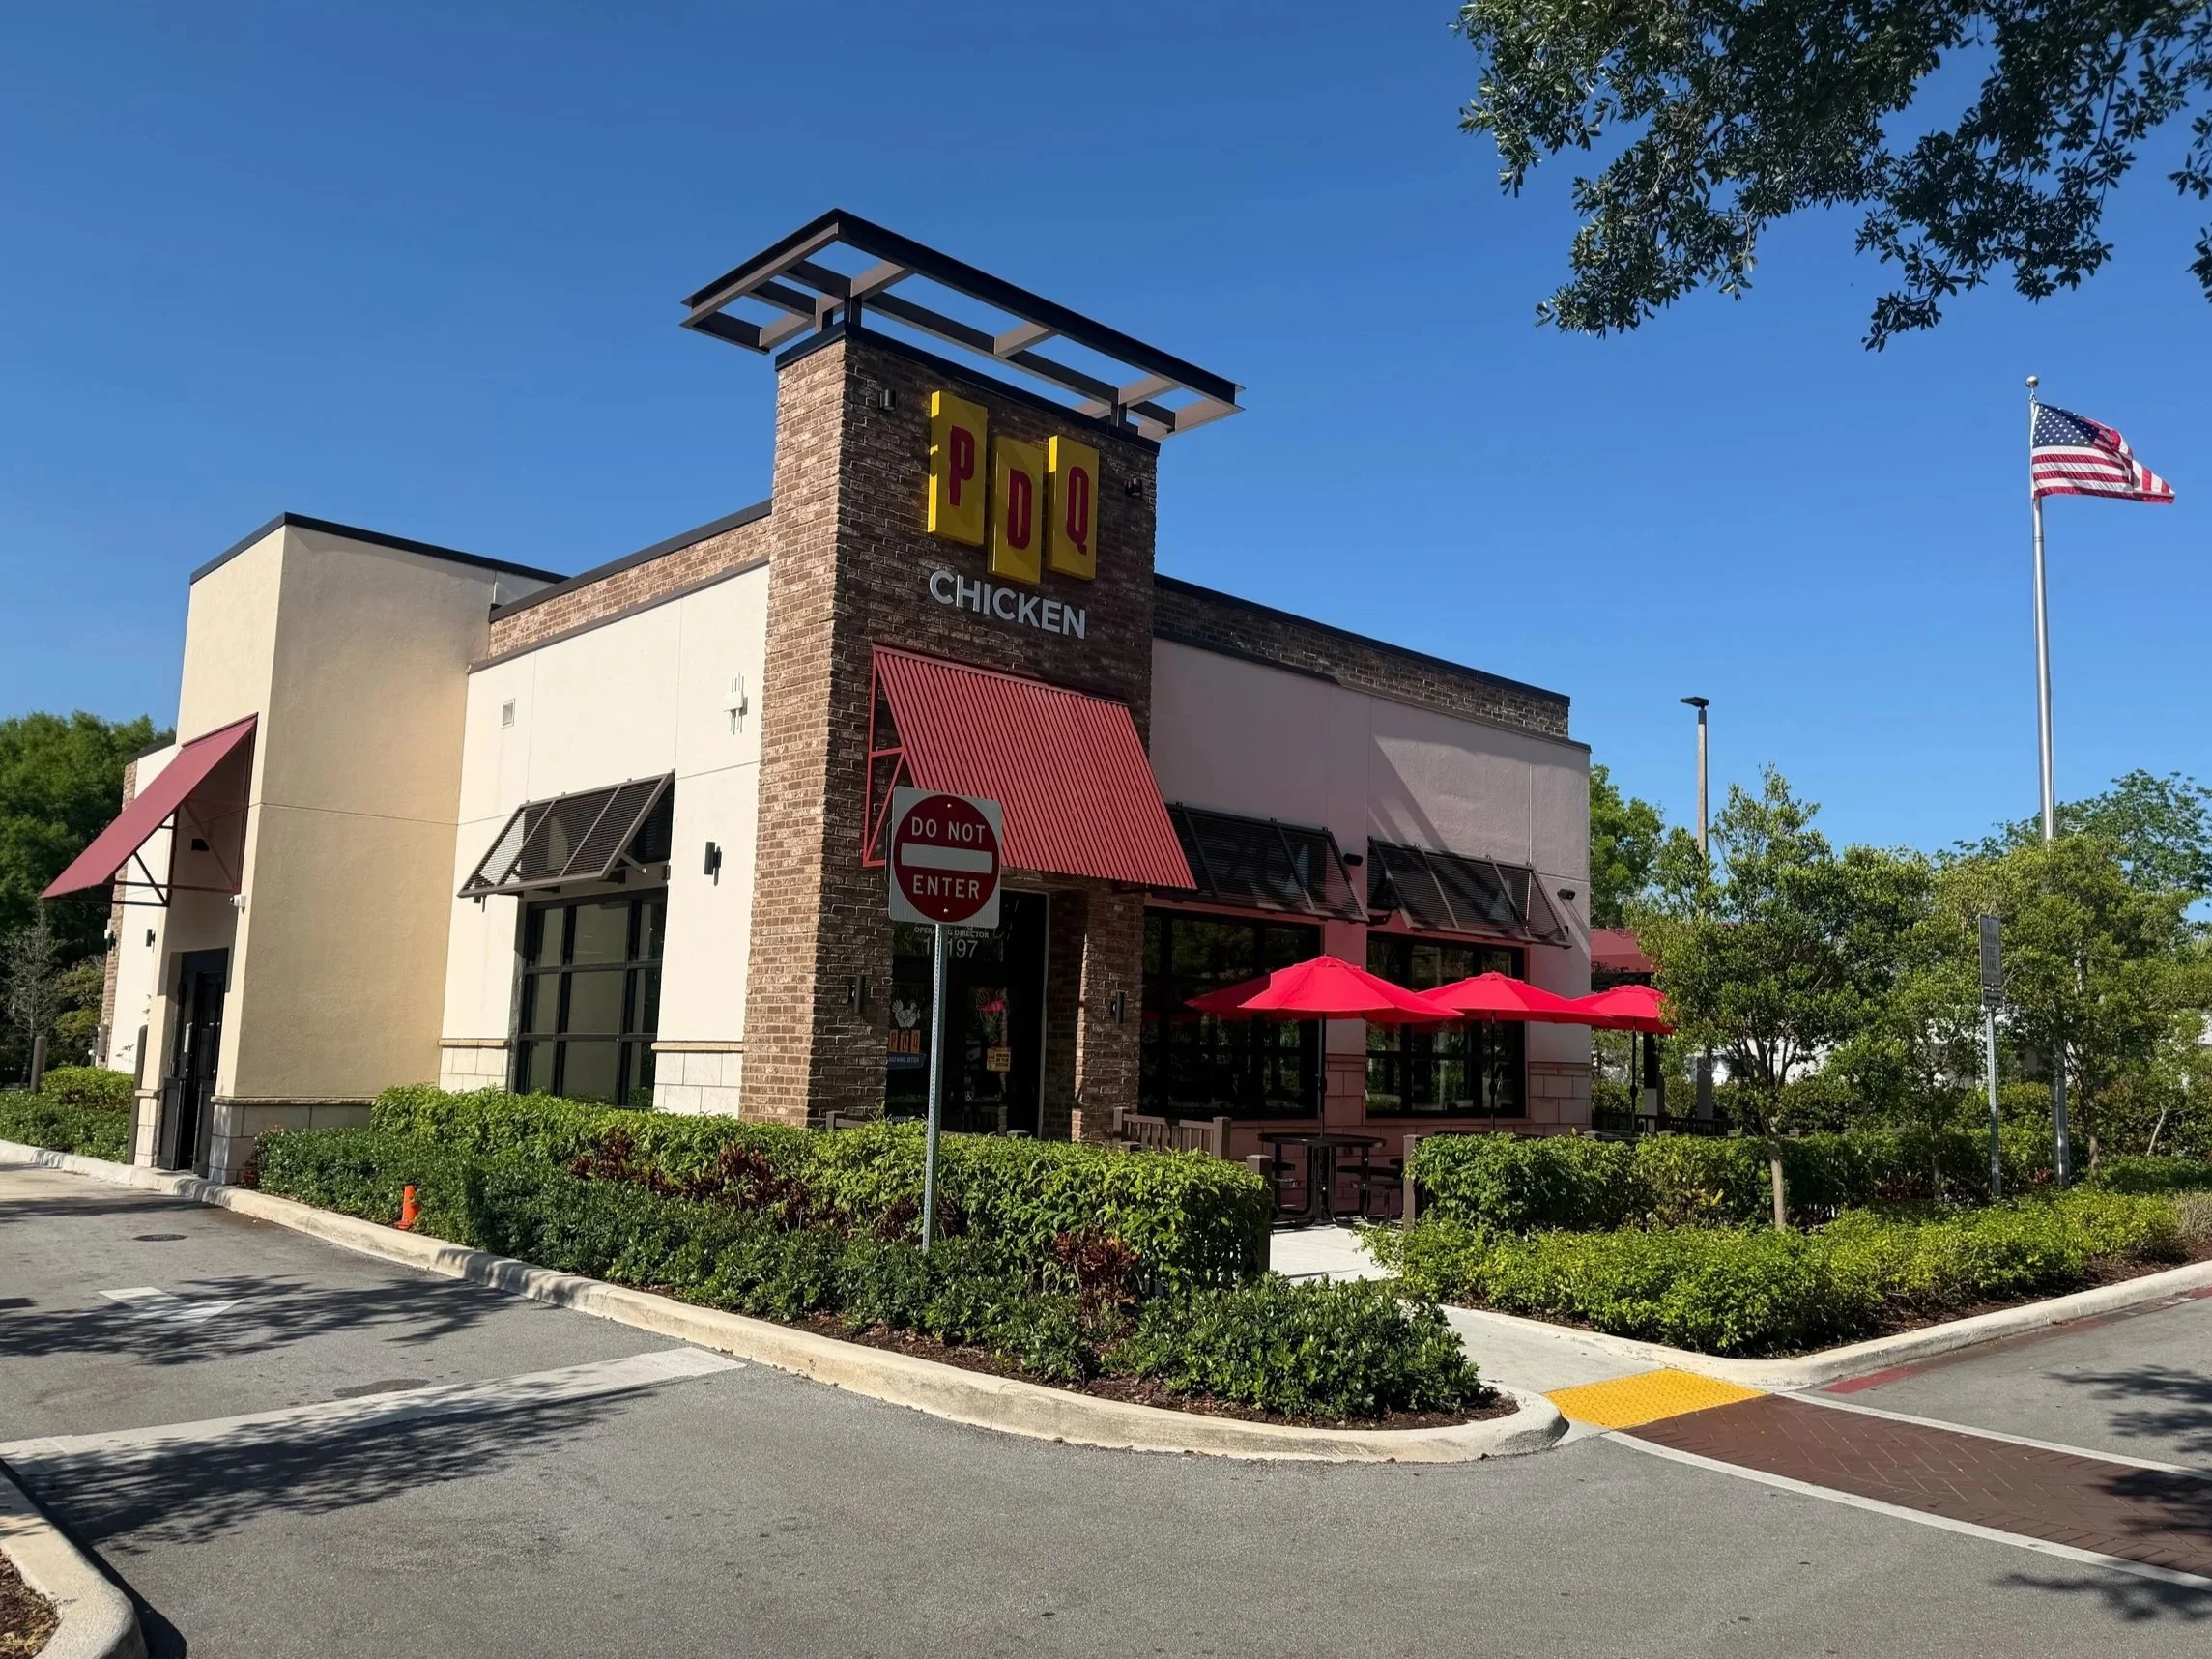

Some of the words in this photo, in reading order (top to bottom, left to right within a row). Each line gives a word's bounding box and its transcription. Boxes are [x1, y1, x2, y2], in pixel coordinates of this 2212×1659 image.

[947, 425, 1089, 557] PDQ
[929, 570, 1086, 640] CHICKEN
[911, 816, 937, 838] DO
[948, 820, 986, 844] NOT
[913, 874, 980, 899] ENTER
[914, 927, 953, 936] OPERAG
[954, 930, 990, 939] DIRECTOR
[924, 937, 978, 958] 1197
